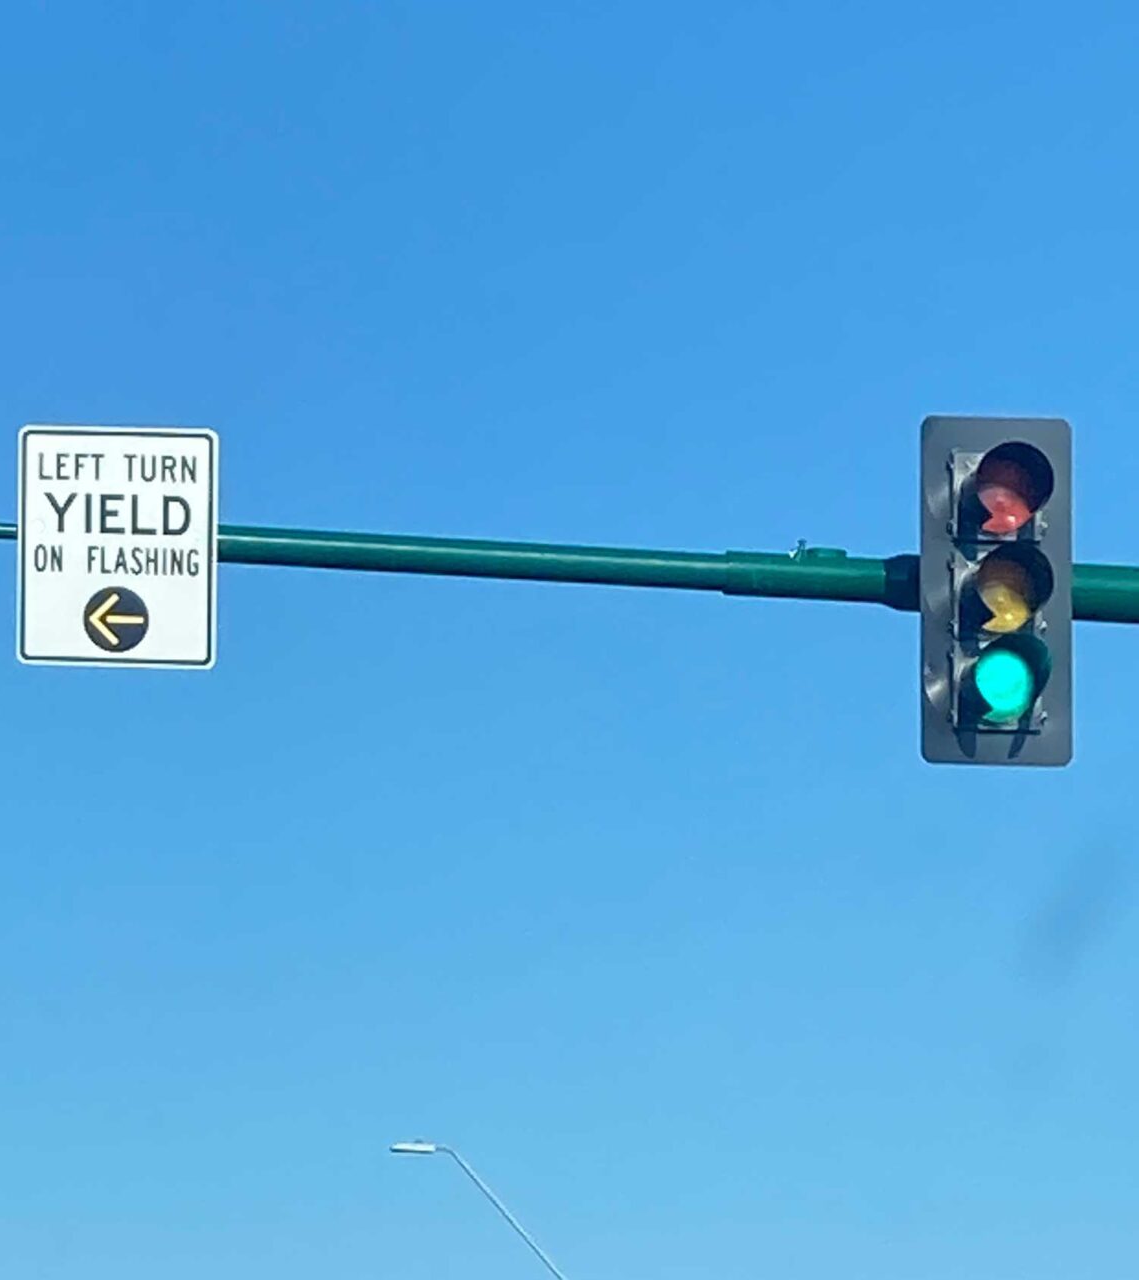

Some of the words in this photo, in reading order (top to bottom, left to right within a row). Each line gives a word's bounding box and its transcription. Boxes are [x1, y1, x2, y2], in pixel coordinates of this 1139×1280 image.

[38, 452, 105, 481] LEFT
[123, 454, 197, 484] TURN
[44, 492, 192, 536] YIELD
[34, 543, 63, 573] ON
[87, 545, 200, 577] FLASHING
